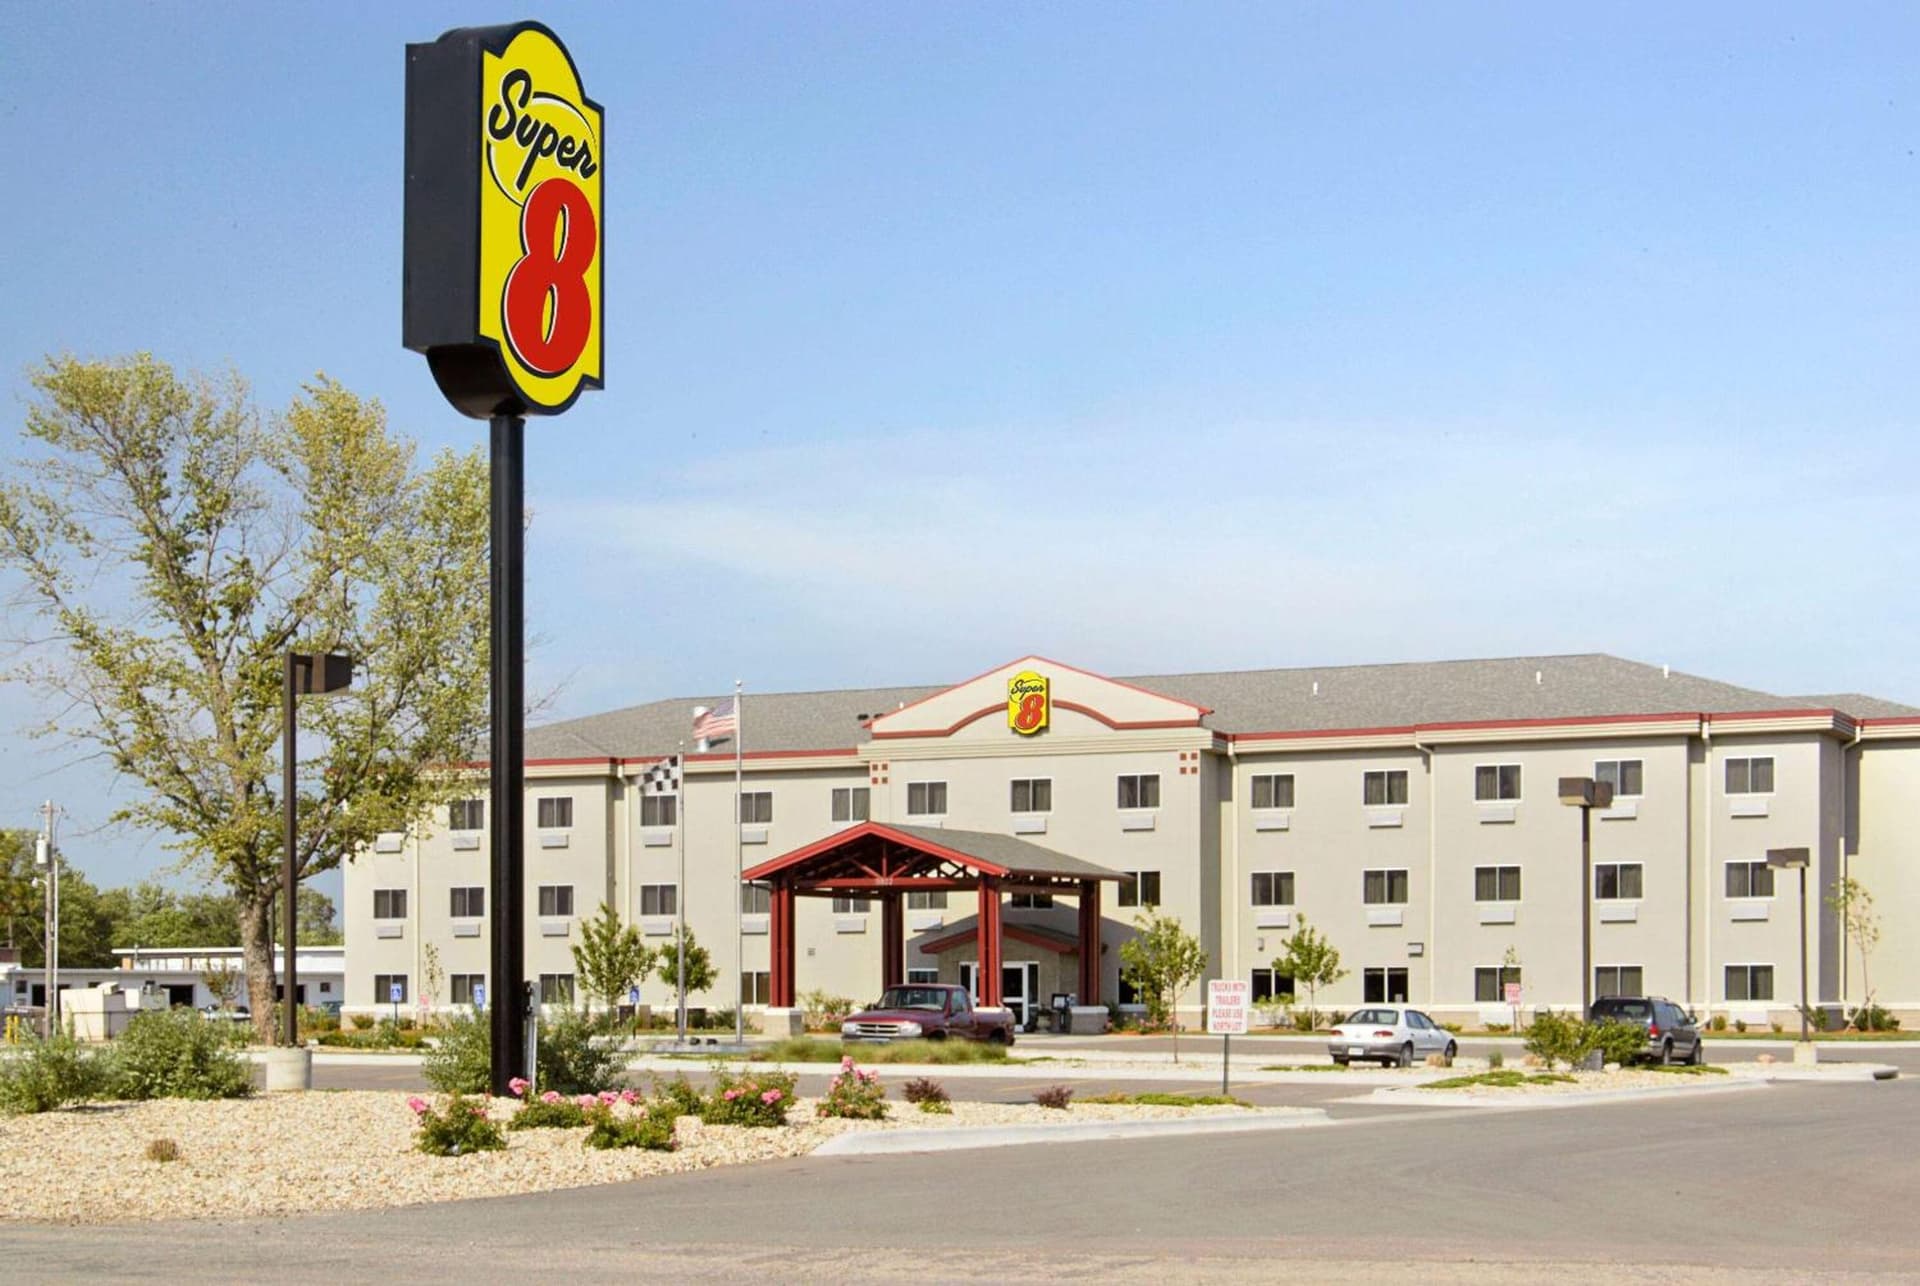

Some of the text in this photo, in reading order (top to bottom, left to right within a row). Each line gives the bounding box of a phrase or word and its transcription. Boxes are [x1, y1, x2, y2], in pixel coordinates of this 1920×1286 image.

[488, 68, 598, 191] Super
[501, 178, 597, 379] 8
[1010, 679, 1044, 701] Super
[1015, 694, 1045, 730] 8
[1212, 1008, 1231, 1018] PLEASE
[1216, 995, 1241, 1005] TRAILERS
